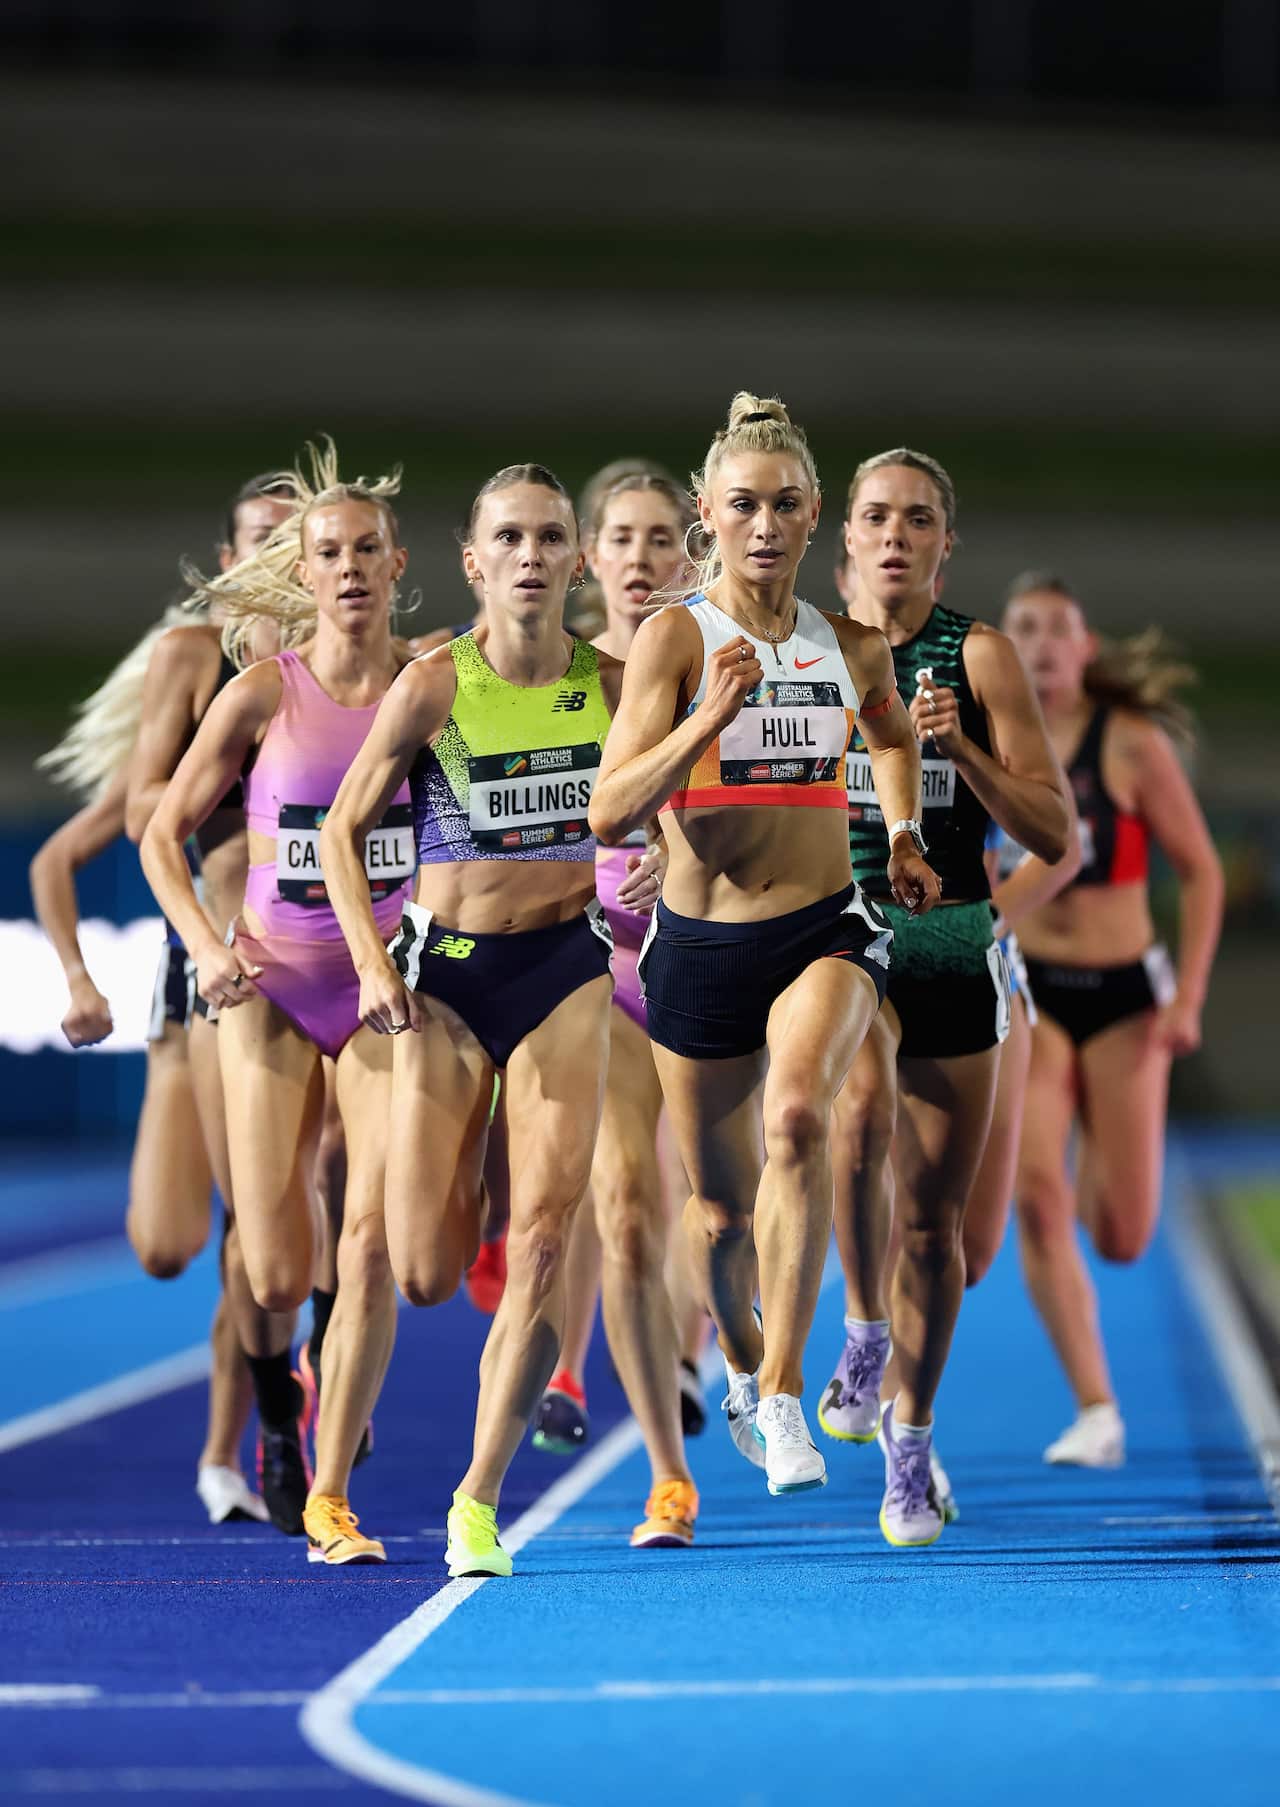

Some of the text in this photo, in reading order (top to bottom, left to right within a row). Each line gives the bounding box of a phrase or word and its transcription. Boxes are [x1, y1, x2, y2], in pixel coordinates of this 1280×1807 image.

[762, 717, 816, 747] HULL
[530, 749, 572, 759] AUSTRALIAN
[530, 755, 573, 766] ATHLETICS
[771, 763, 804, 771] SUMMER
[771, 770, 796, 778] SERIES
[489, 780, 591, 818] BILLINGS
[521, 827, 555, 837] SUMMER
[521, 835, 547, 844] SERIES
[288, 838, 406, 869] CAELL
